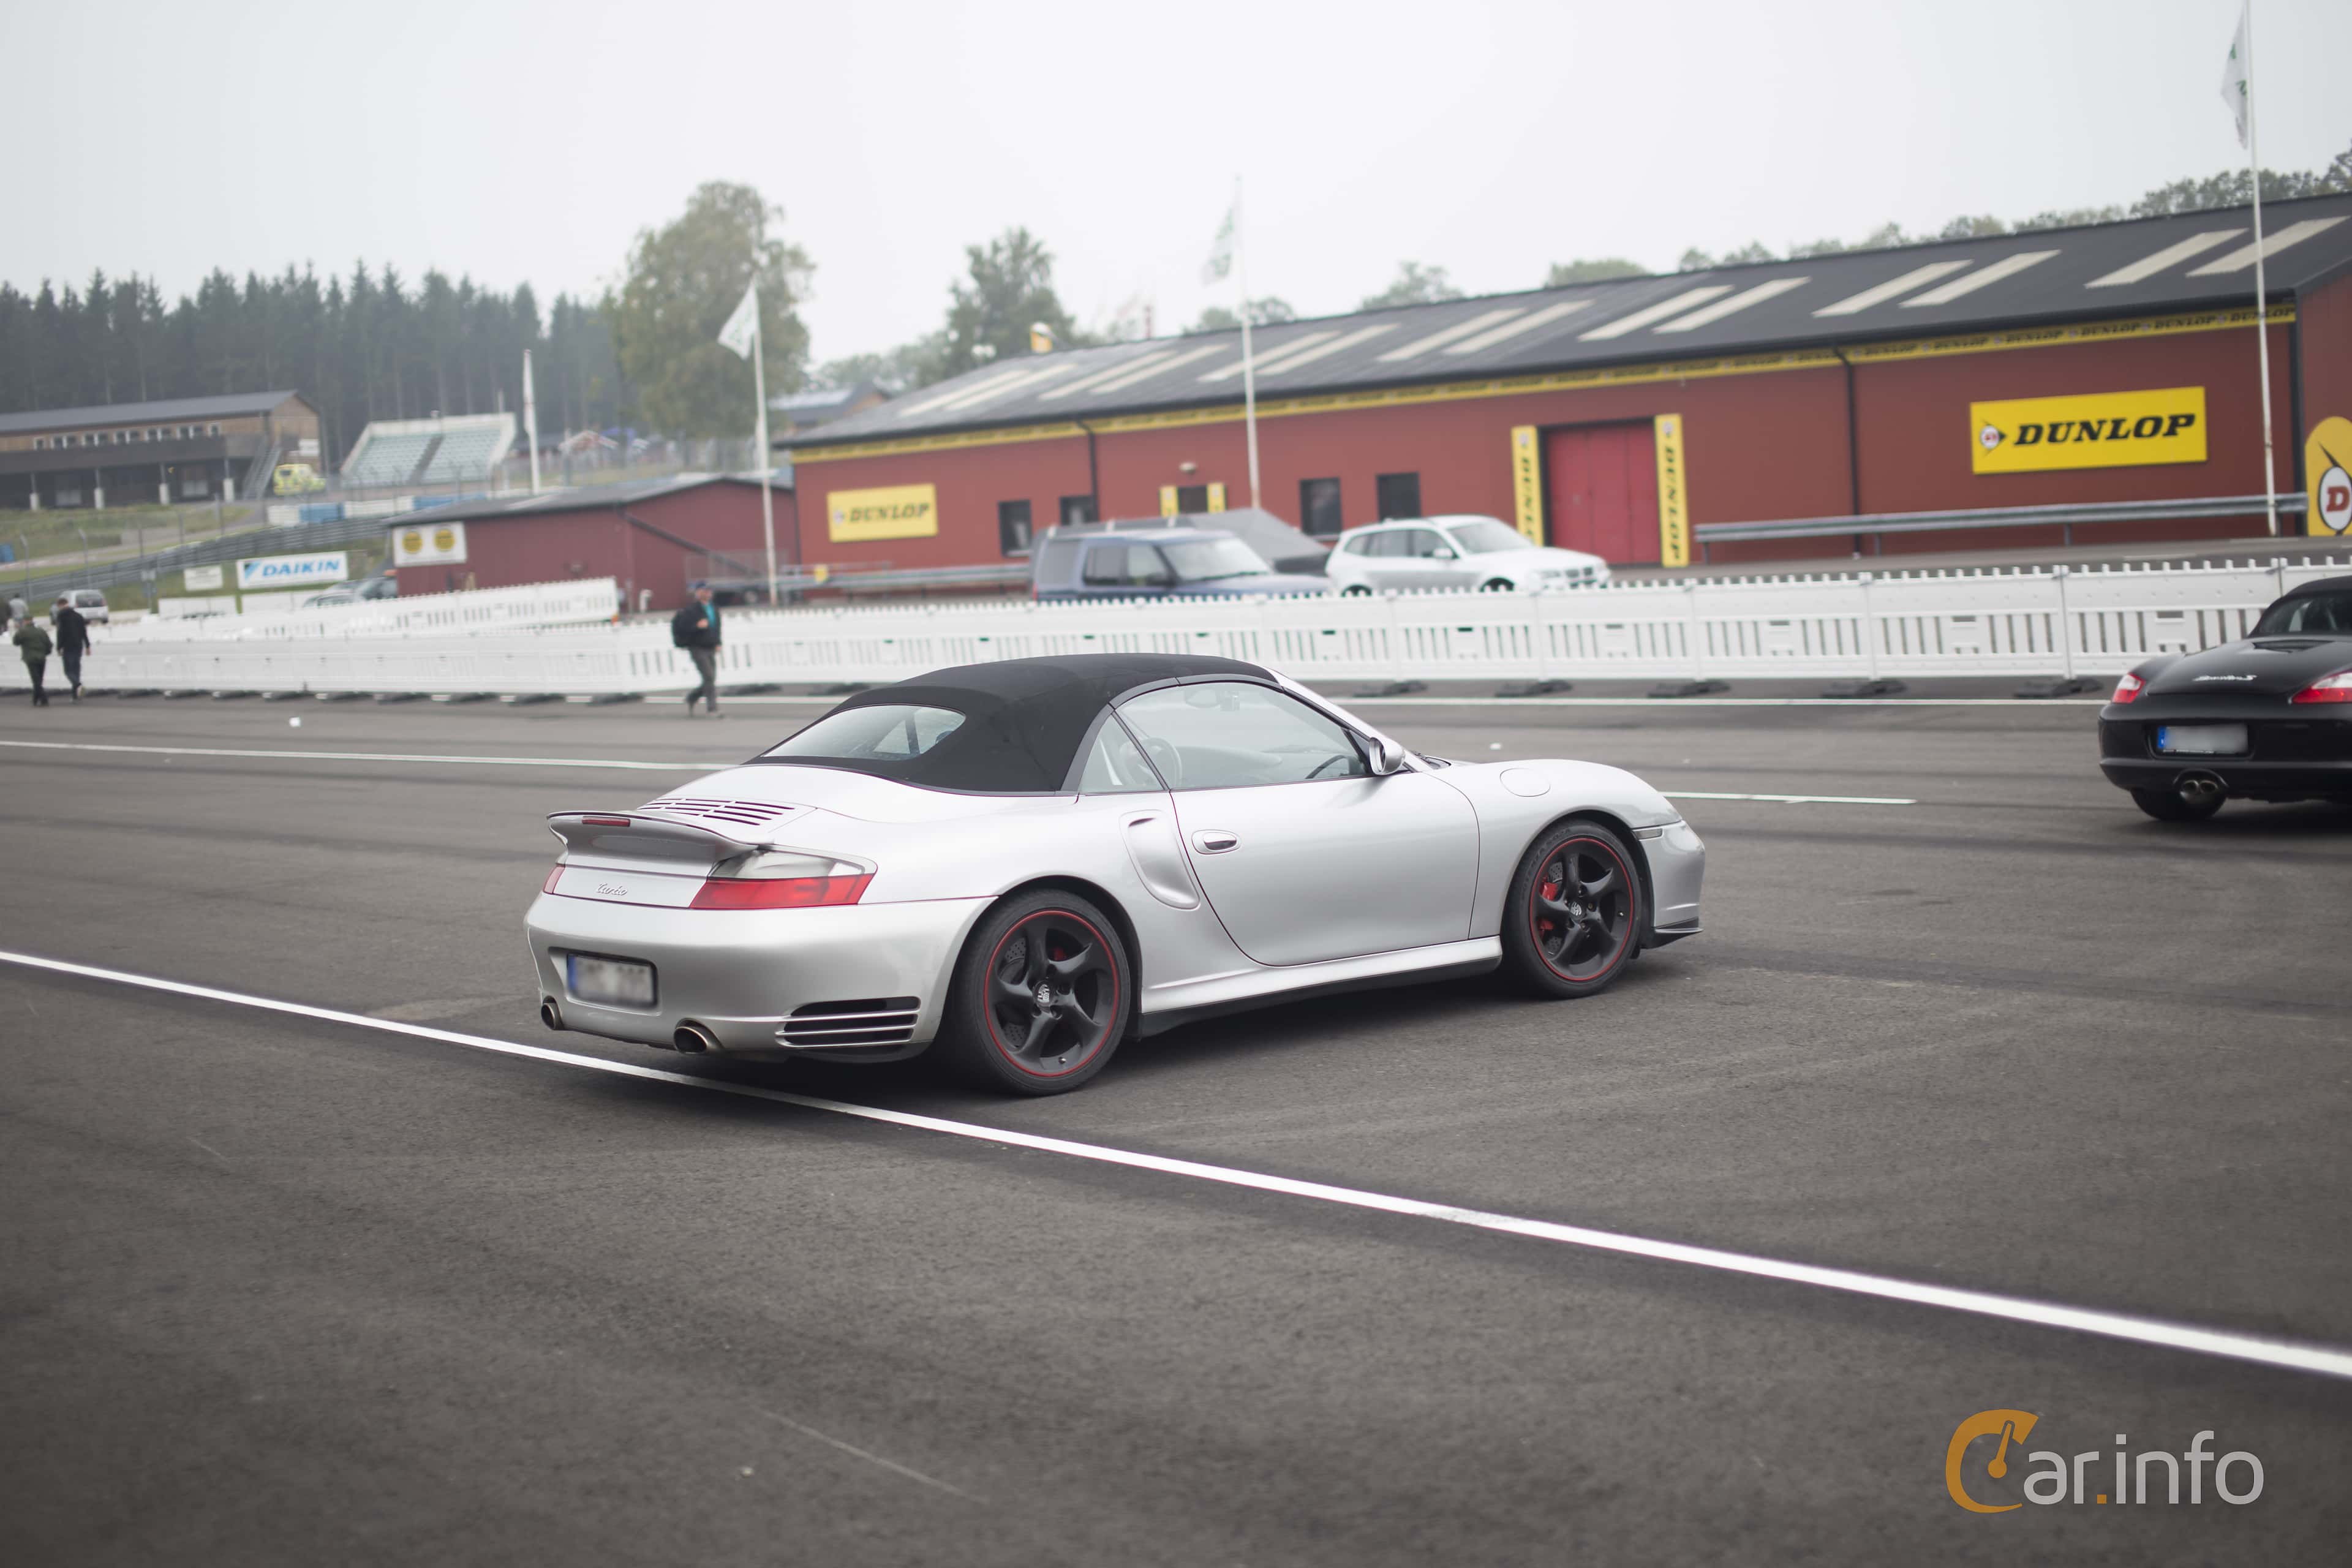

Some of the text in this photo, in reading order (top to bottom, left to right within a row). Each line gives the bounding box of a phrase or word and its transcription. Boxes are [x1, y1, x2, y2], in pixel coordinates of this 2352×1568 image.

[2013, 413, 2196, 446] DUNLOP
[850, 502, 930, 522] DUNLOP
[262, 559, 341, 576] DAIKIN
